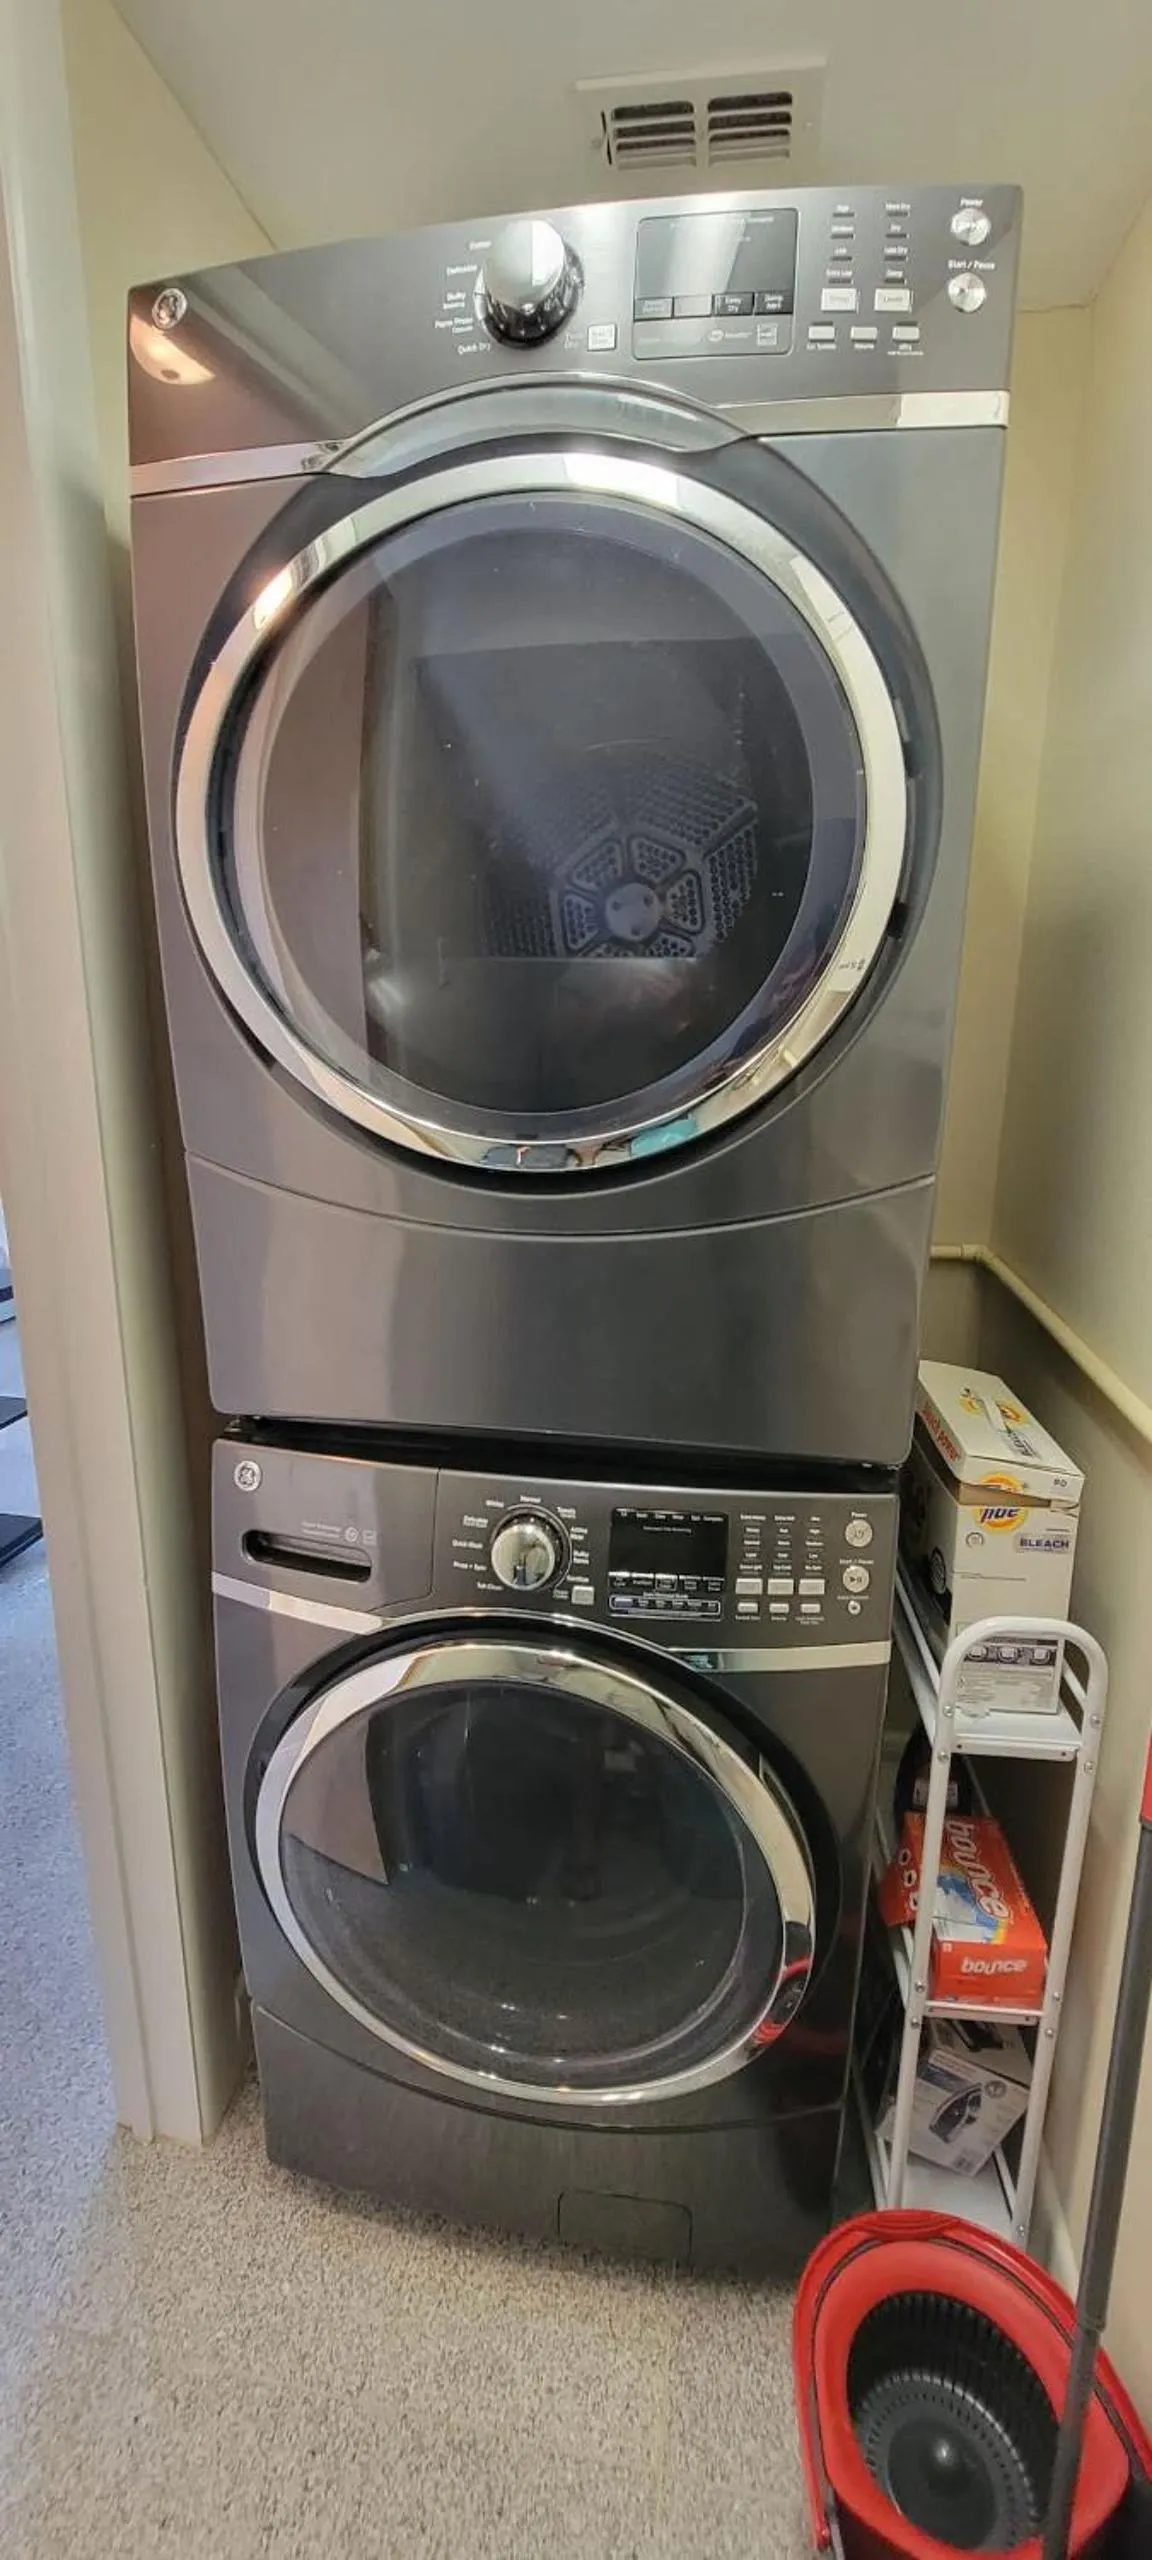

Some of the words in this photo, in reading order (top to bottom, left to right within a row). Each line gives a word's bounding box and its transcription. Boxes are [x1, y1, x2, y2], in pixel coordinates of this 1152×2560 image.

[960, 198, 984, 207] Power
[948, 259, 967, 270] Start
[974, 261, 995, 270] Pause
[1020, 1537, 1070, 1549] BLEACH
[944, 1819, 1011, 1920] bounce
[961, 1957, 1027, 1974] bounce
